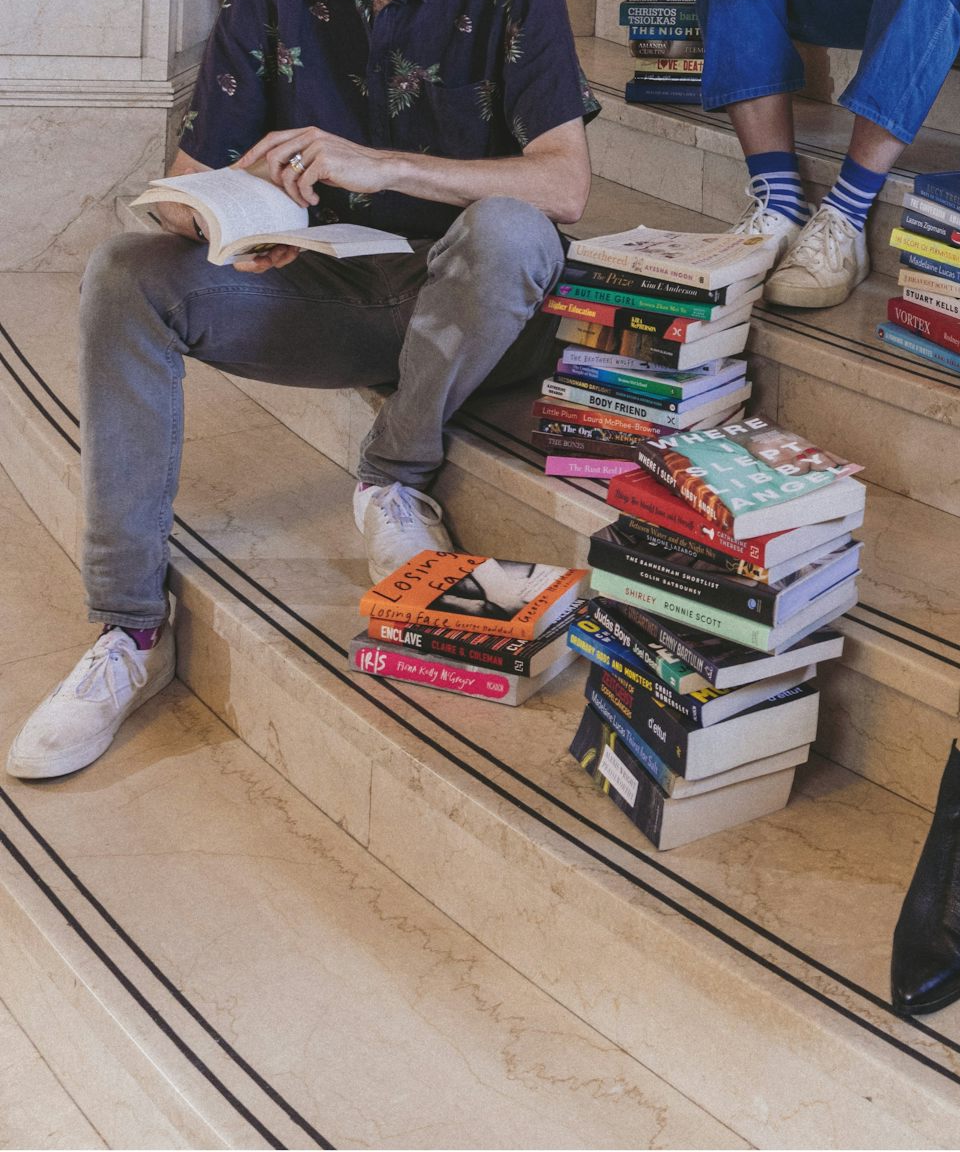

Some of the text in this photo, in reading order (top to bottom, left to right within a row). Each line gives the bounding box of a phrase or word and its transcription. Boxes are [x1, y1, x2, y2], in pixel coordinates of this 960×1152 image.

[628, 8, 677, 17] CHRISTOS
[628, 16, 676, 25] TSIOLKAS
[632, 26, 700, 36] THE NIGHT
[576, 244, 629, 267] Untethered
[606, 272, 698, 296] Prize Kim Anderson
[939, 266, 956, 279] Lucas
[574, 288, 636, 306] BUT THE GIRL
[906, 289, 959, 314] STUART KELLS
[568, 303, 597, 318] Education
[895, 307, 931, 335] VORTEX
[583, 413, 603, 424] Laura
[589, 395, 613, 409] BODY
[614, 402, 647, 418] FRIEND
[562, 424, 577, 434] The
[647, 418, 768, 449] WHERE
[638, 452, 657, 474] WHERE
[660, 470, 677, 488] SLEPT
[681, 485, 697, 506] LIBBY
[698, 499, 717, 520] ANGEL
[646, 534, 669, 549] SIMONE
[717, 531, 748, 547] CATHERINE
[372, 550, 460, 603] Losing
[428, 558, 487, 593] Face
[626, 554, 720, 590] THE BANNERMAN SHORTLIST
[640, 571, 702, 596] COLIN BATROUNEY
[369, 604, 449, 628] Losing Face
[625, 587, 723, 628] SHIRLEY RONNIE SCOTT
[594, 607, 632, 647] Judas Boys
[380, 625, 504, 666] ENCLAVE CLAIRE COLEMAN
[611, 659, 673, 698] AND MONSTERS CHRIS
[655, 691, 689, 716] WOMERSLEY
